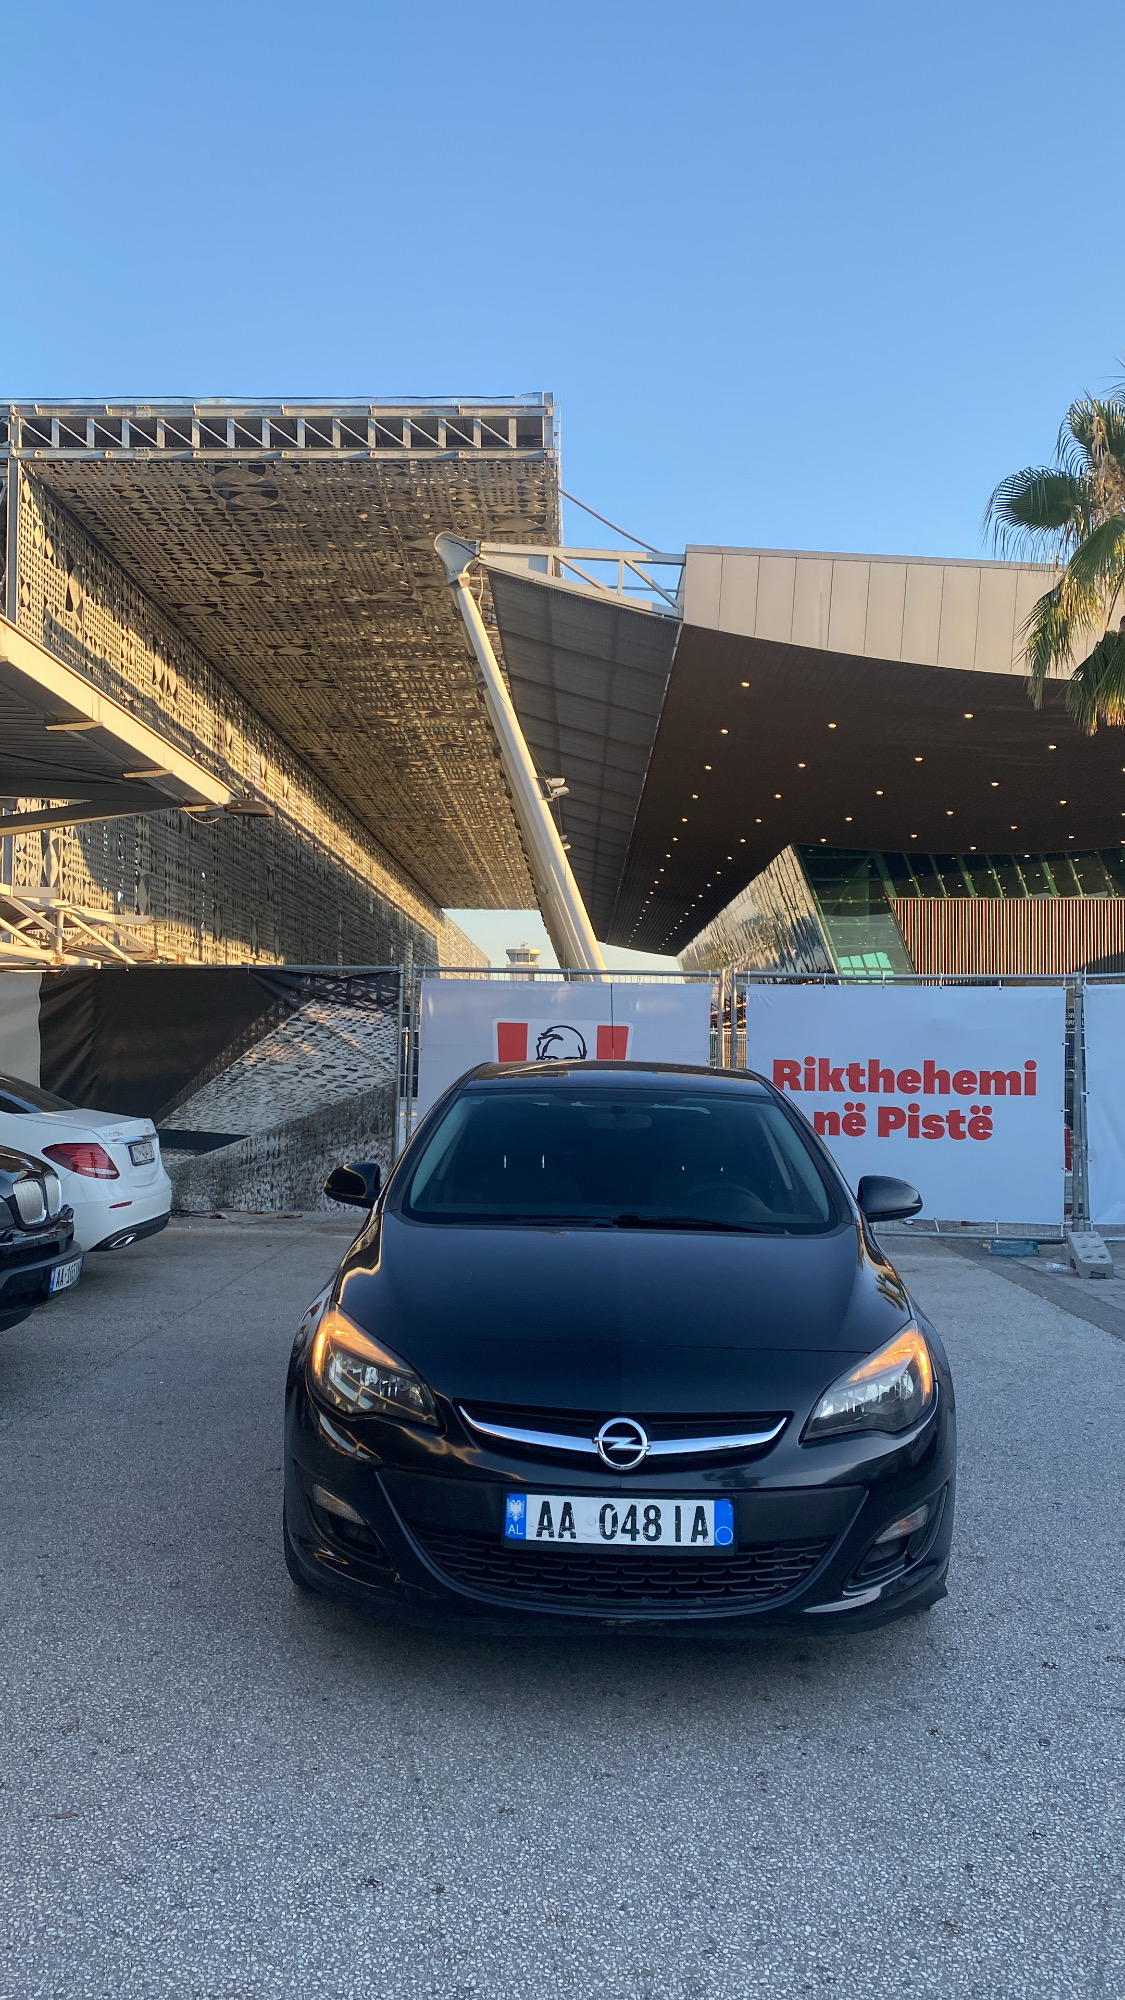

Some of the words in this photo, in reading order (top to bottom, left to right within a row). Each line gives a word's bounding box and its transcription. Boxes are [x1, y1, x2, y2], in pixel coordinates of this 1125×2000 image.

[772, 1056, 1037, 1096] Rikthehemi
[813, 1101, 866, 1137] në
[877, 1103, 993, 1140] Pistë
[508, 1524, 523, 1535] AL
[536, 1501, 577, 1538] AA
[599, 1503, 662, 1541] 048
